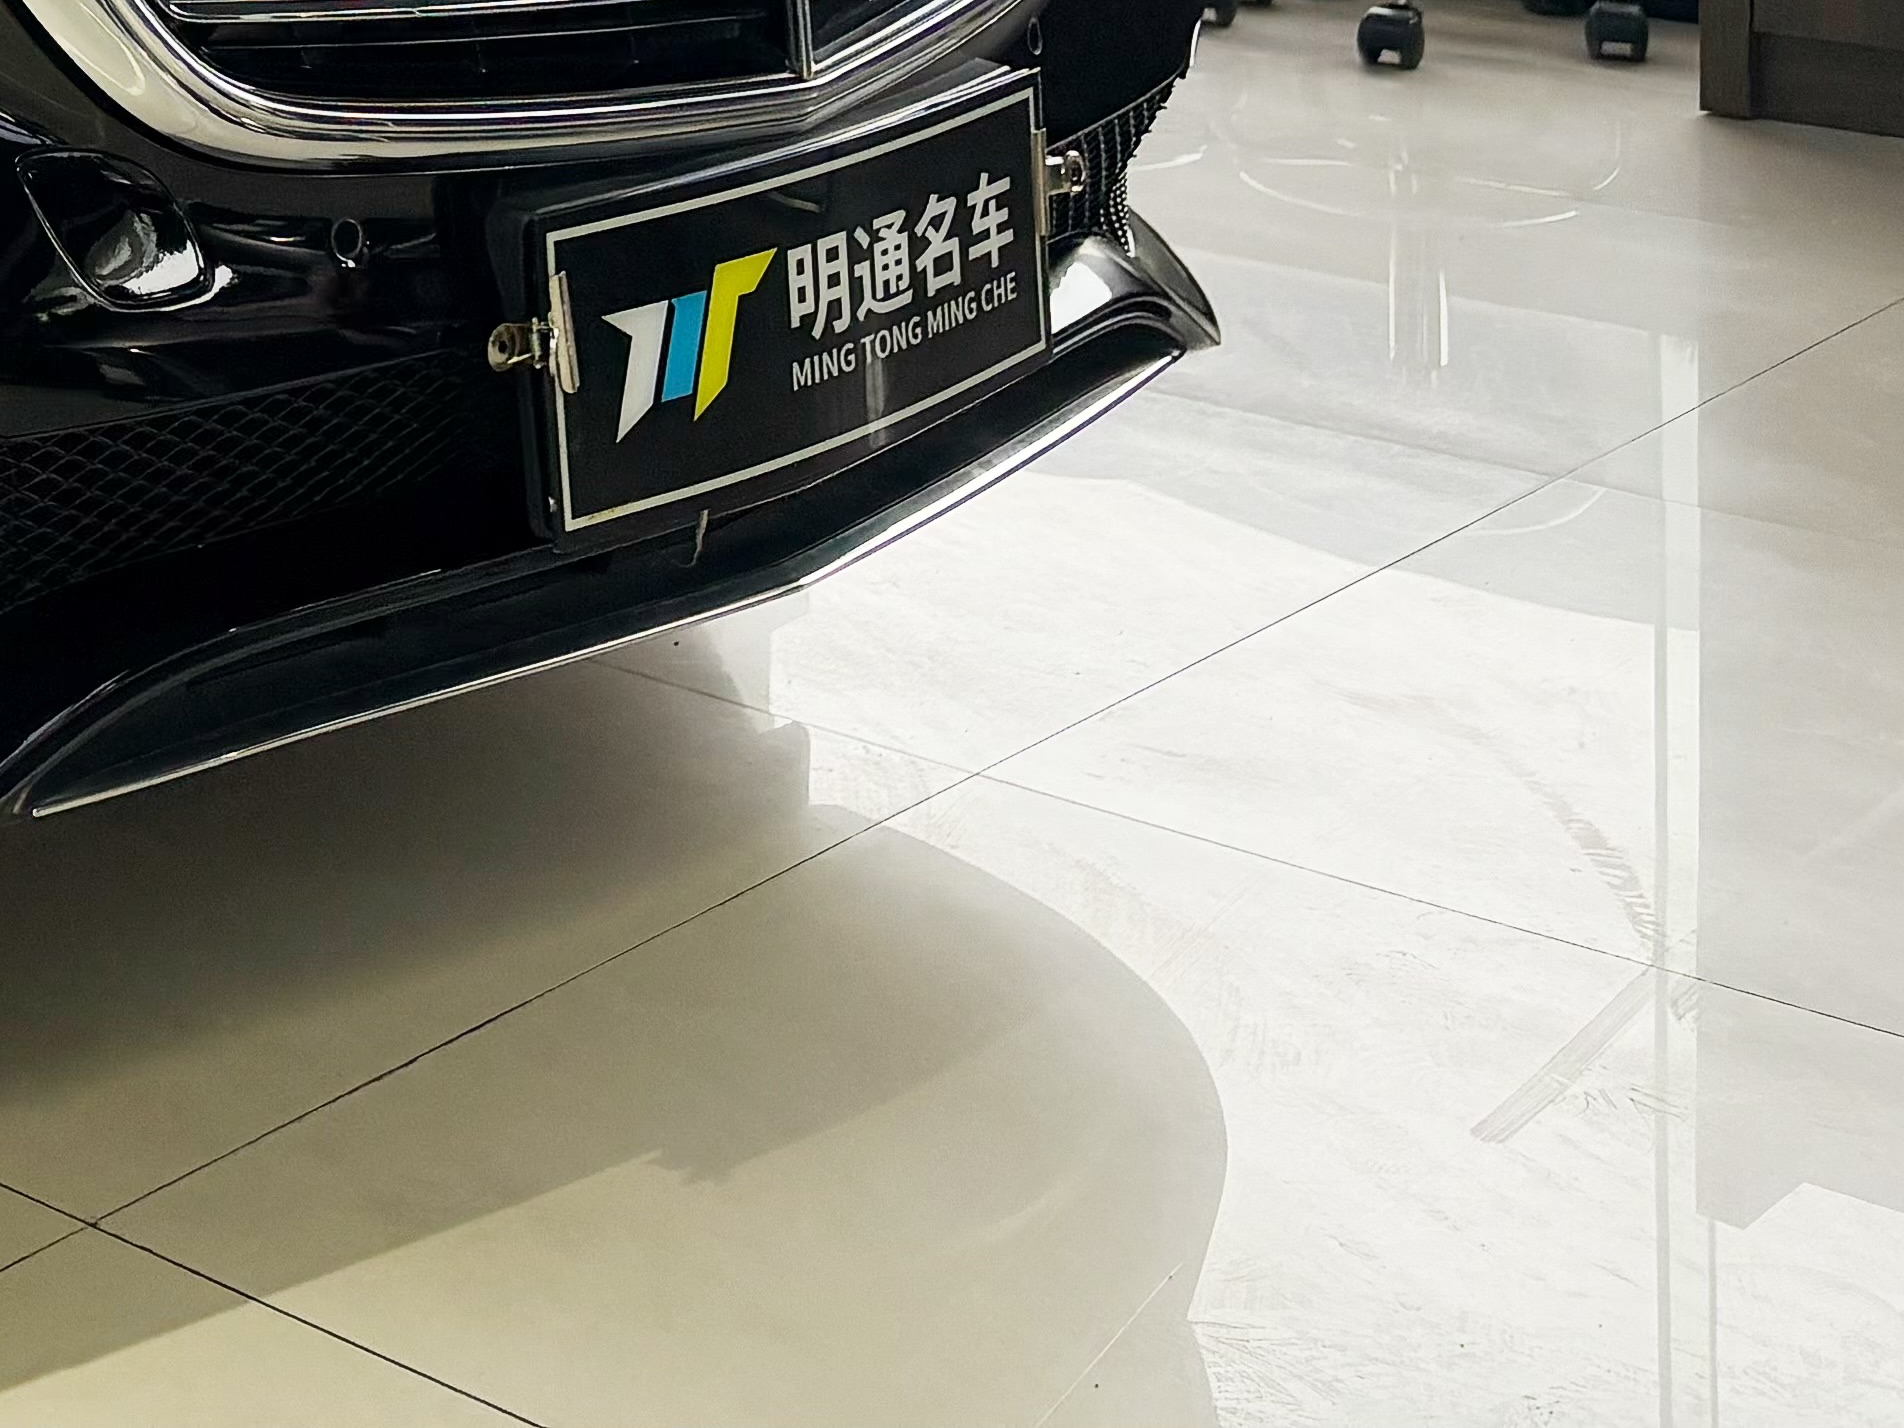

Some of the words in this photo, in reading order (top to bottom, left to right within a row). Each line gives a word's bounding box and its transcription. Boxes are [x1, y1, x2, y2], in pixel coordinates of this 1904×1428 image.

[786, 171, 1015, 341] 明通名车
[791, 342, 857, 392] MING
[859, 315, 924, 365] TONG
[926, 290, 979, 339] MING
[980, 271, 1019, 313] CHE
